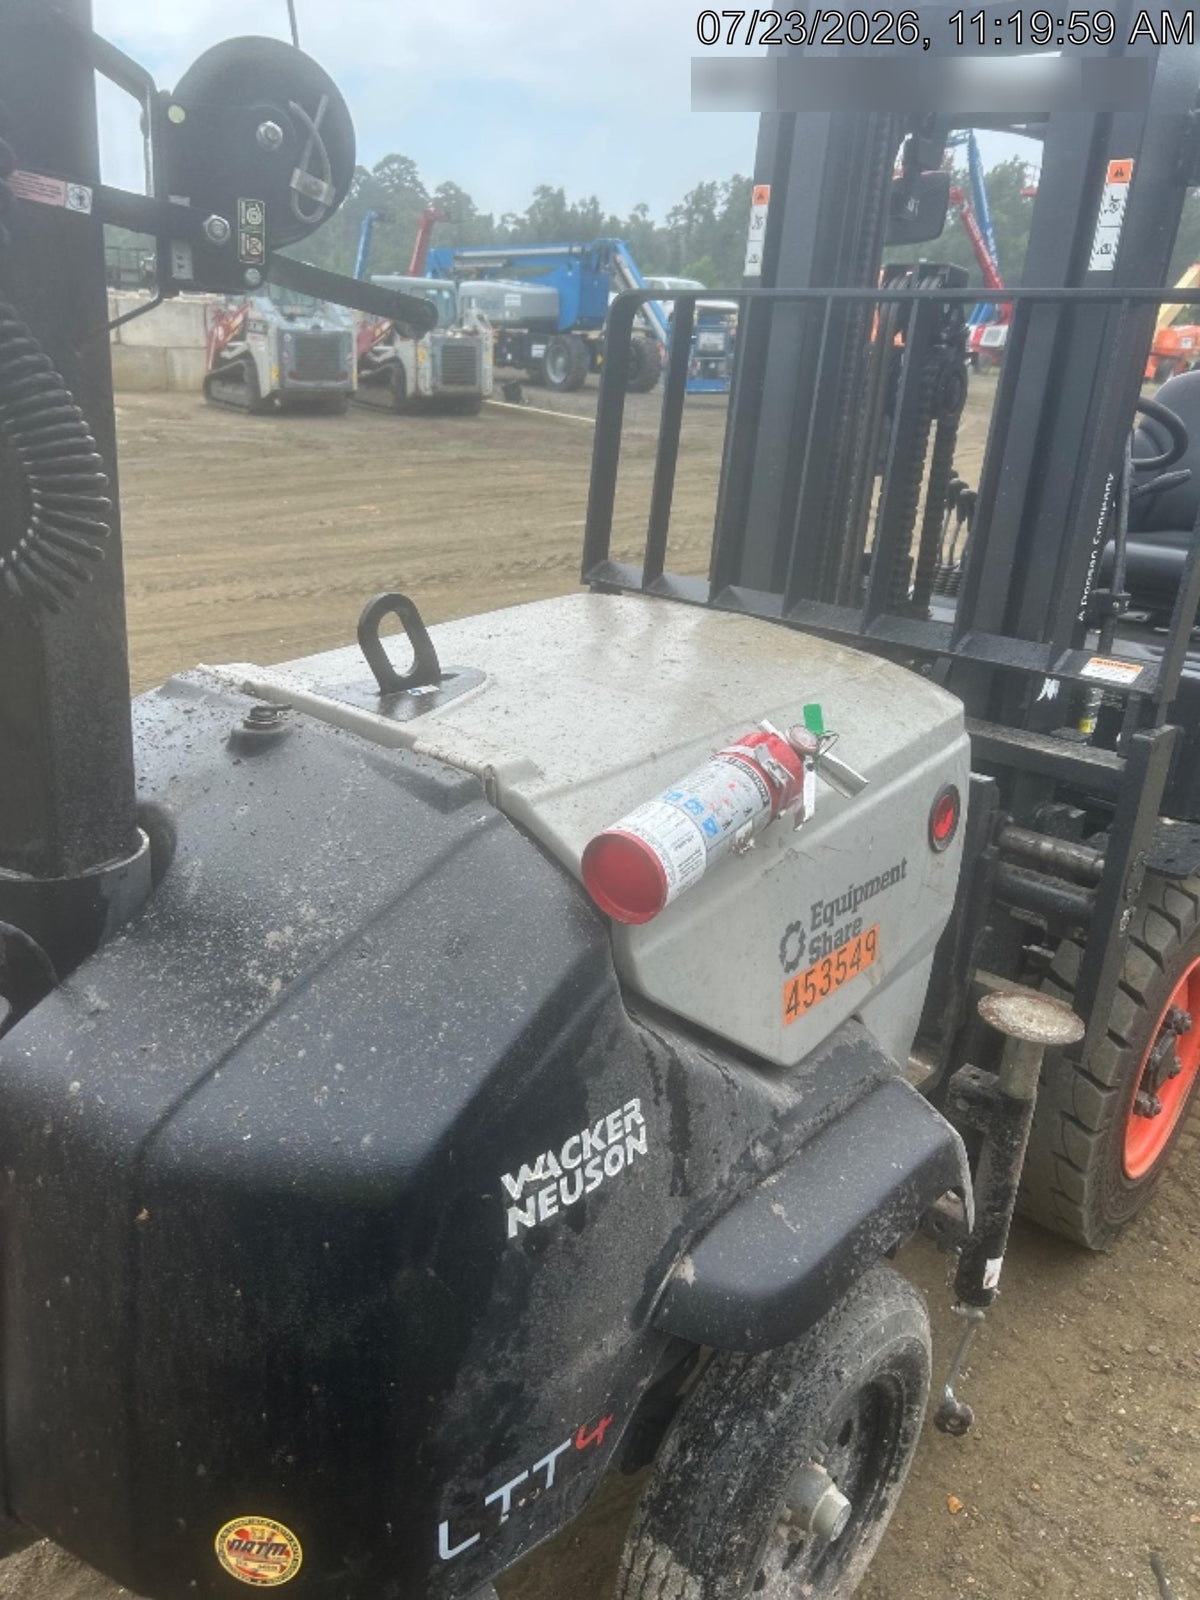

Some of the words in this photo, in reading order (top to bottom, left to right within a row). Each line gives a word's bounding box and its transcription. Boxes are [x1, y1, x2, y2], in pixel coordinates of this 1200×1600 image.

[810, 857, 908, 932] Equipment
[785, 929, 877, 1016] 453549
[808, 917, 864, 966] Share
[500, 1098, 645, 1201] WACKER
[507, 1124, 648, 1239] NEUSON
